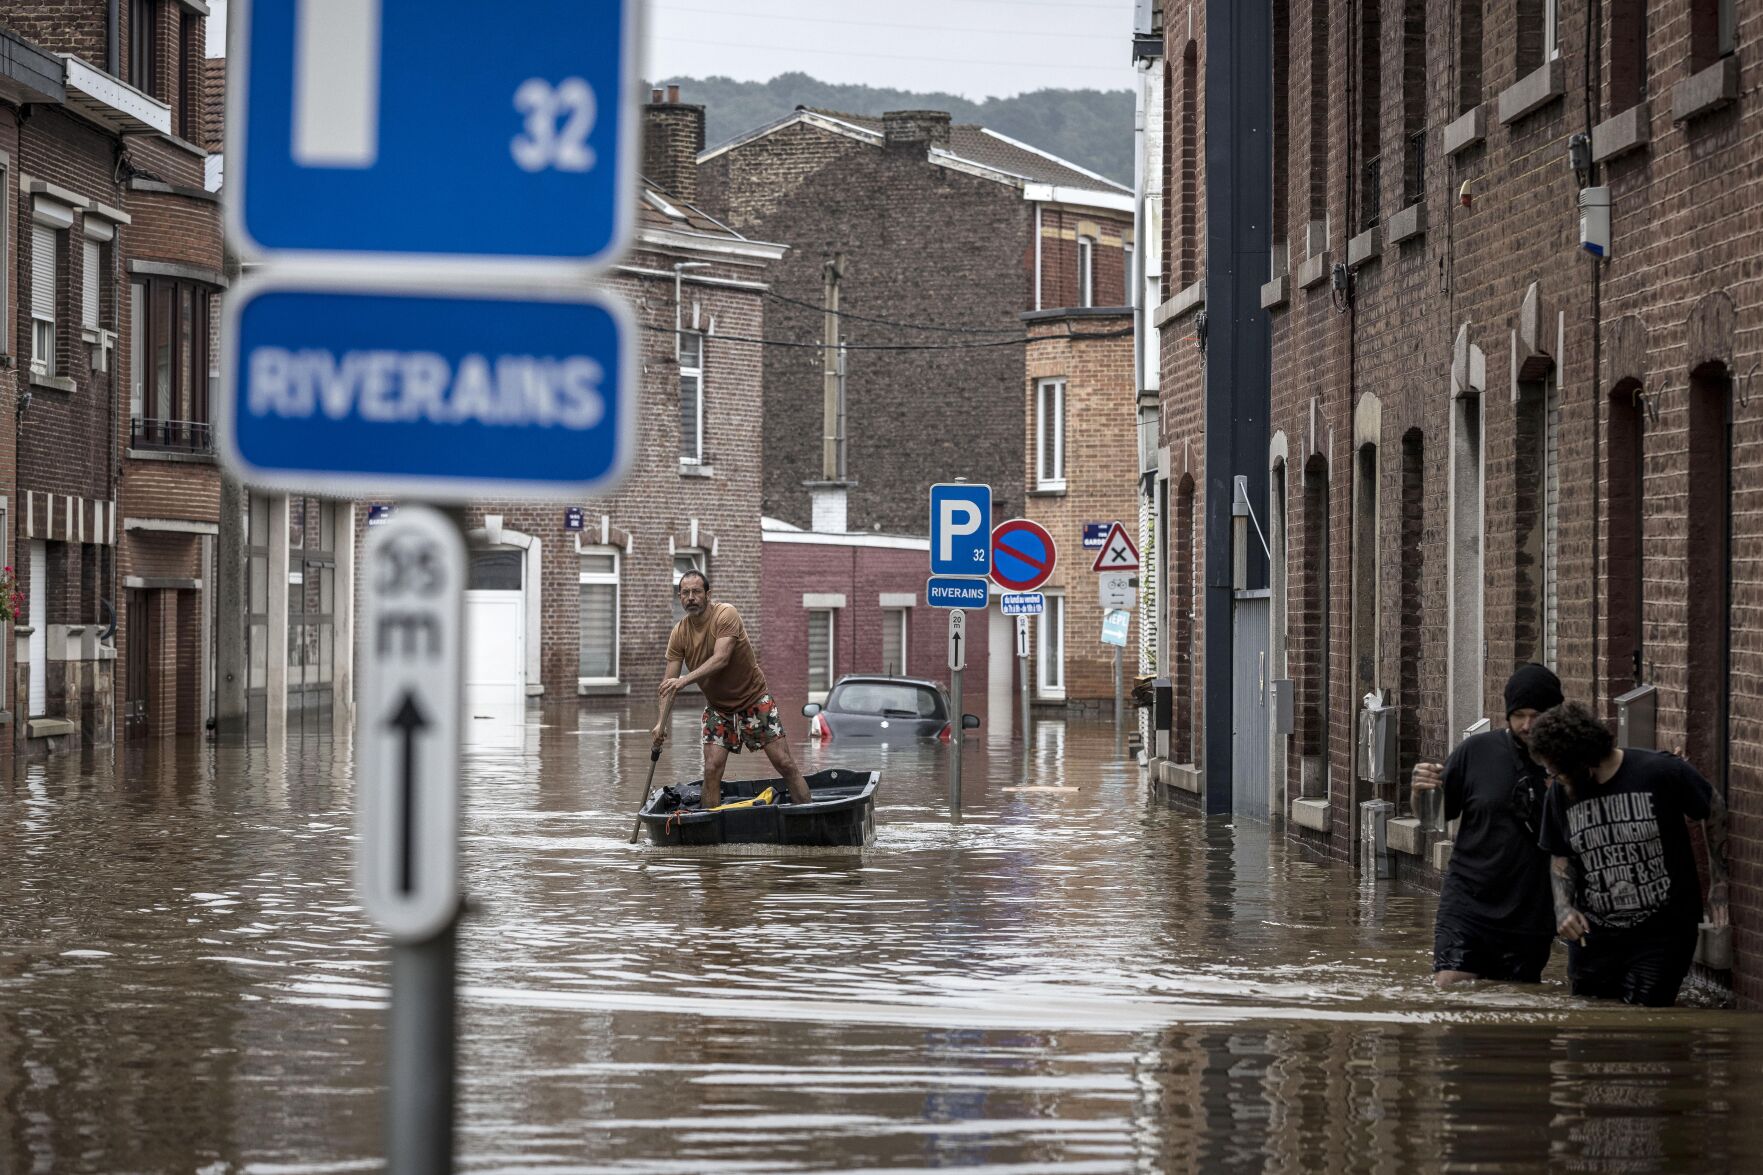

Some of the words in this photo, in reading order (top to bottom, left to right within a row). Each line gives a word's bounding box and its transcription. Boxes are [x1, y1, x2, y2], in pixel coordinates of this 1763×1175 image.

[511, 77, 598, 173] 32
[247, 345, 605, 430] RIVERAINS
[940, 500, 982, 561] P
[973, 549, 985, 561] 32
[931, 587, 984, 598] RIVERAINS
[376, 609, 443, 664] m
[1566, 797, 1602, 835] WHEN
[1601, 793, 1631, 822] YOU
[1630, 792, 1657, 820] DIE
[1584, 823, 1611, 850] ONLY
[1611, 820, 1660, 844] KINGDOM
[1603, 844, 1627, 867] SEE
[1625, 843, 1639, 863] IS
[1638, 837, 1664, 860] TWO
[1635, 862, 1649, 884] &
[1647, 855, 1668, 879] SIX
